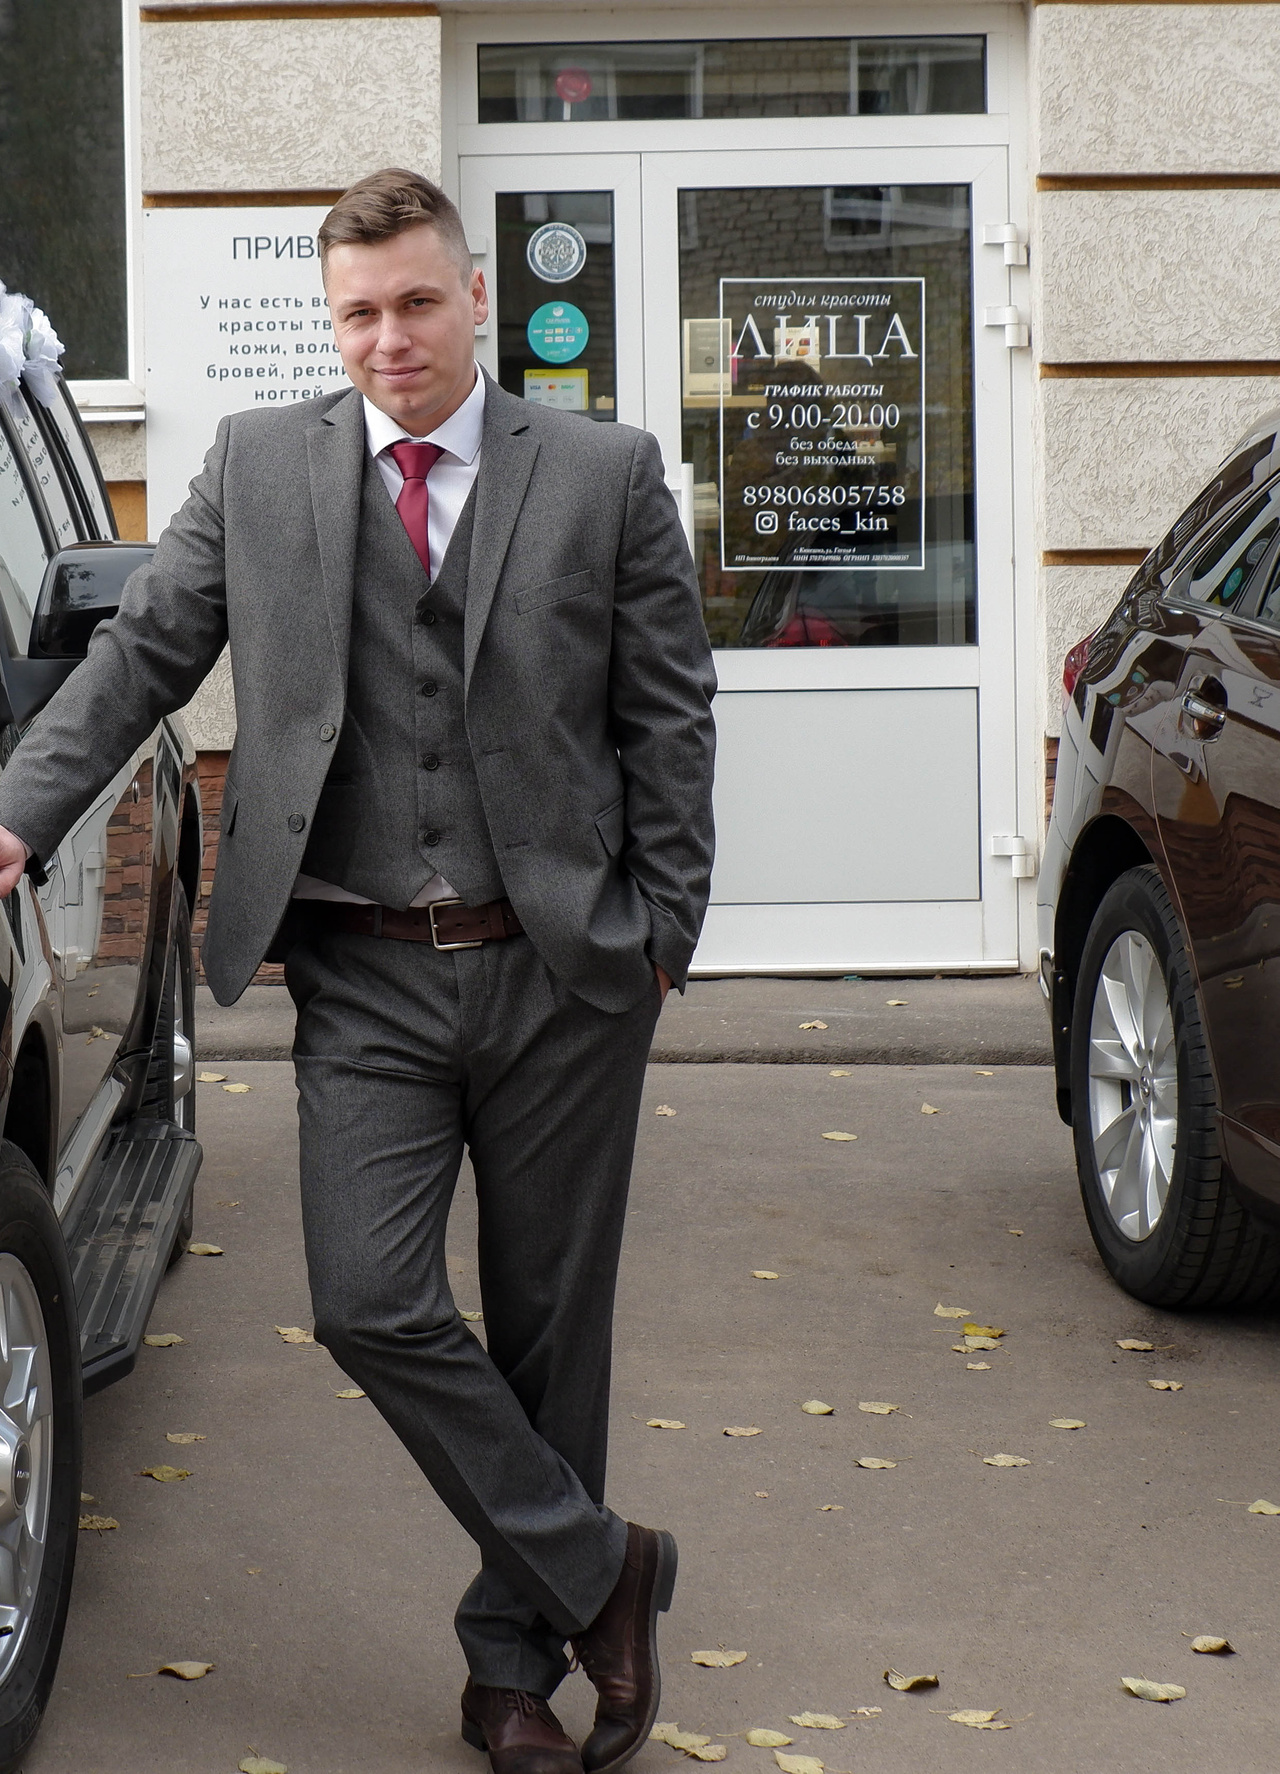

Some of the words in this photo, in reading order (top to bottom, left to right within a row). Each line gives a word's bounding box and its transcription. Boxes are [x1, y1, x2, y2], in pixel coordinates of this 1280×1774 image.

[233, 236, 320, 259] ПРИВ
[200, 295, 210, 309] У
[218, 298, 252, 309] нас
[260, 296, 303, 308] есть
[754, 290, 816, 310] студия
[820, 293, 892, 309] красоты
[219, 319, 303, 335] красоты
[727, 312, 919, 367] ЛИЦА
[229, 343, 287, 356] кожи,
[206, 364, 285, 381] бровей,
[255, 385, 323, 400] ногтей
[764, 384, 823, 397] ГРАФИК
[825, 384, 884, 397] РАБОТЫ
[747, 411, 761, 429] с
[769, 403, 901, 430] 9.00-20.00
[790, 437, 813, 450] без
[817, 437, 859, 450] обеда
[776, 452, 799, 465] без
[803, 455, 876, 466] выходных
[743, 485, 906, 506] 89806805758
[787, 511, 889, 534] faces_kin
